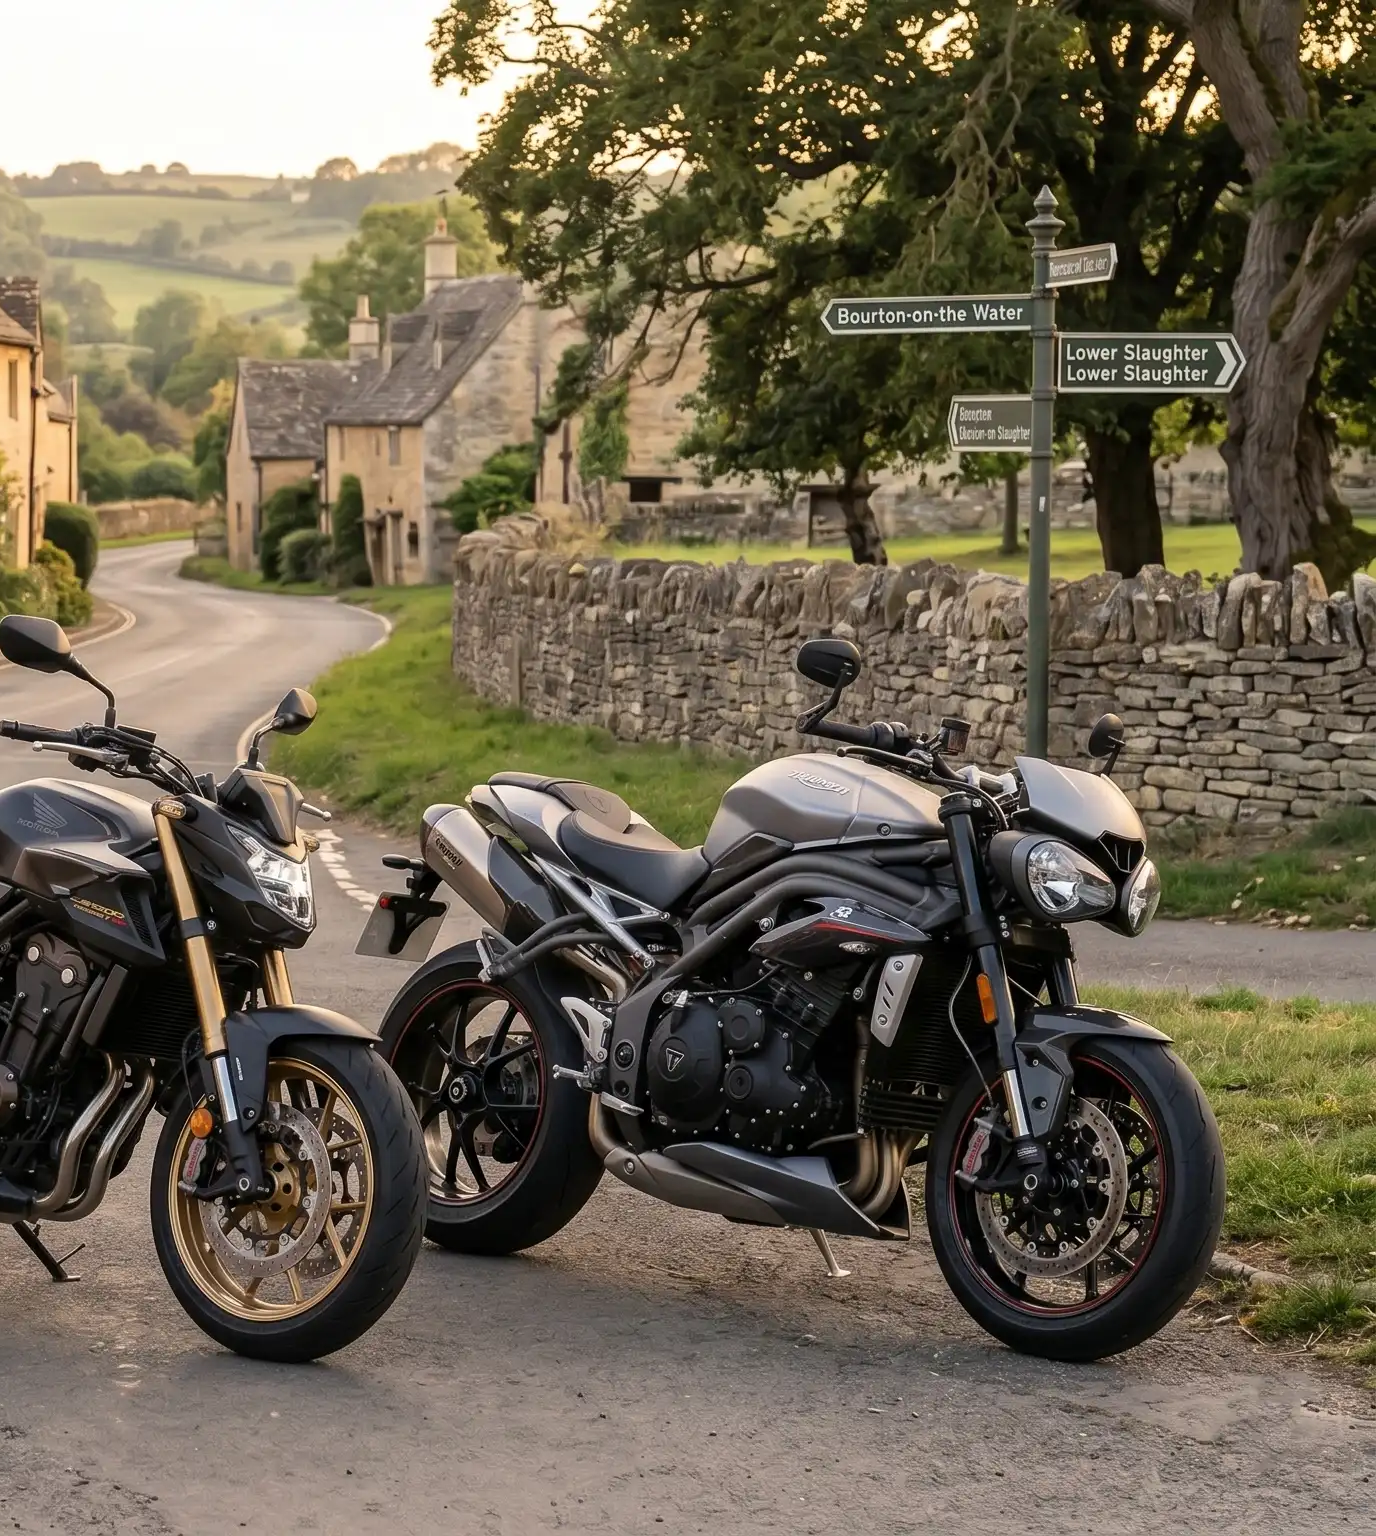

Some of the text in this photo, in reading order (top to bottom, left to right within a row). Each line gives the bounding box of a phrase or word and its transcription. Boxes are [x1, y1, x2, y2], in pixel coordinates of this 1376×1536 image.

[837, 303, 1024, 325] Bourton-on-the Water
[1066, 343, 1208, 364] Lower Slaughter
[1067, 364, 1208, 385] Lower Slaughter
